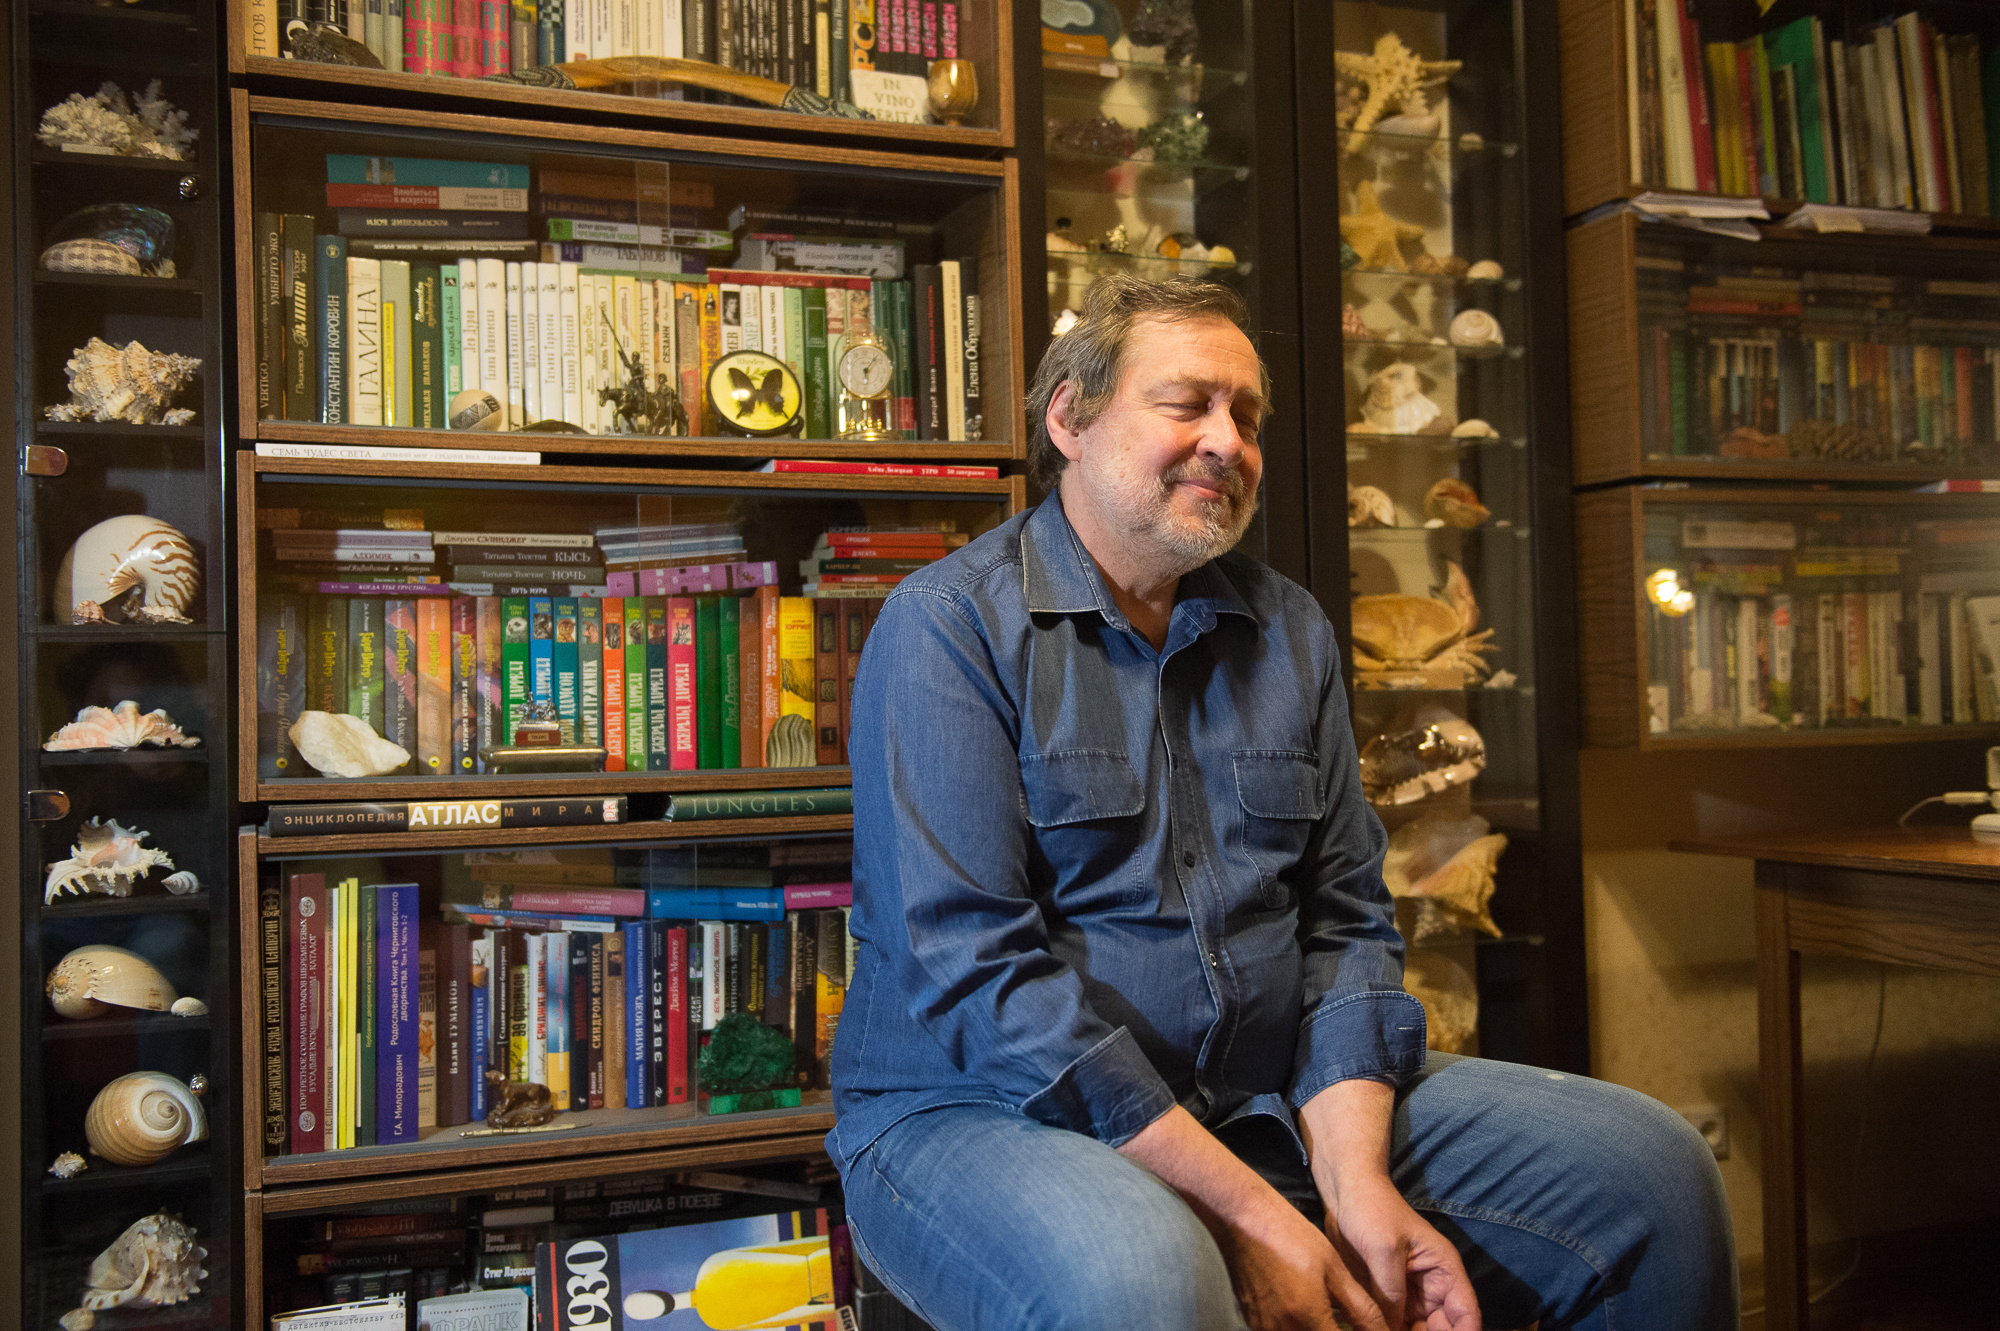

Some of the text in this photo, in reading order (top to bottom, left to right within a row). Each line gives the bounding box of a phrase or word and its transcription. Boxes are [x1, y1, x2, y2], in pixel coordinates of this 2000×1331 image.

[874, 92, 915, 109] VINO
[883, 77, 900, 91] IN
[268, 231, 280, 306] УМБЕРТО ЭКО
[326, 294, 341, 425] КОНСТАНТИН КОРОВИН
[356, 288, 379, 397] ГАЛИНА
[543, 314, 556, 384] Татьяна Тарасова
[662, 325, 671, 364] СЕЗАНН
[964, 295, 980, 398] Елена Образцова
[259, 362, 269, 409] VERTIGO
[566, 359, 578, 394] Владимир
[423, 389, 432, 428] МИХАИЛ
[271, 448, 300, 458] СЕМЬ
[303, 448, 338, 459] ЧУДЕС
[340, 450, 373, 460] СВЕТА
[921, 467, 939, 475] УТРО
[352, 552, 393, 561] АЛХИМИК
[476, 535, 527, 544] СЭЛИНДЖЕР
[482, 551, 592, 563] Татьяна Толстая КЫСЬ
[481, 570, 587, 581] Татьяна Толстая НОЧЬ
[510, 587, 528, 595] ПУТЬ
[559, 671, 576, 716] АДАМСОН
[582, 659, 598, 707] ГРЖИМЕК
[606, 669, 622, 708] ДАРРЕЛЛ
[628, 672, 643, 709] ДАРРЕЛЛ
[649, 668, 665, 706] ДАРРЕЛЛ
[674, 663, 692, 702] ДАРРЕЛЛ
[284, 803, 593, 826] ЭНЦИКЛОПЕДИЯ АТЛАС МИРА
[603, 801, 617, 821] DK
[691, 794, 816, 818] JUNGLES
[265, 920, 279, 964] ИМПЕРИИ
[308, 933, 317, 971] КАТАЛОГ
[400, 927, 408, 946] Часть
[389, 892, 400, 1046] Родословная Книга Черниговского
[400, 953, 408, 967] Том
[400, 967, 409, 1022] дворянства.
[510, 972, 528, 1037] 99 франков
[537, 959, 547, 1041] БРИДЖИТ ДЖОНС
[590, 943, 603, 1049] СИНДРОМ ФЕНИКСА
[634, 994, 645, 1027] МОЗГА
[298, 918, 308, 1111] ПОРТРЕТНОЕ СОБРАНИЕ ГРАФОВ ШЕРЕМЕТЕВЫХ
[448, 980, 458, 1075] Вадим ТУМАНОВ
[653, 968, 664, 1063] ЭВЕРЕСТ
[266, 1026, 281, 1052] РОДЫ
[634, 1026, 645, 1061] МАГИЯ
[309, 1050, 318, 1088] УСАДЬБЕ
[394, 1054, 404, 1136] Г.А. Милорадович
[608, 1192, 723, 1218] ДЕВУШКА В ПОЕЗДЕ
[483, 1266, 504, 1280] Стиг
[564, 1239, 613, 1331] 1930
